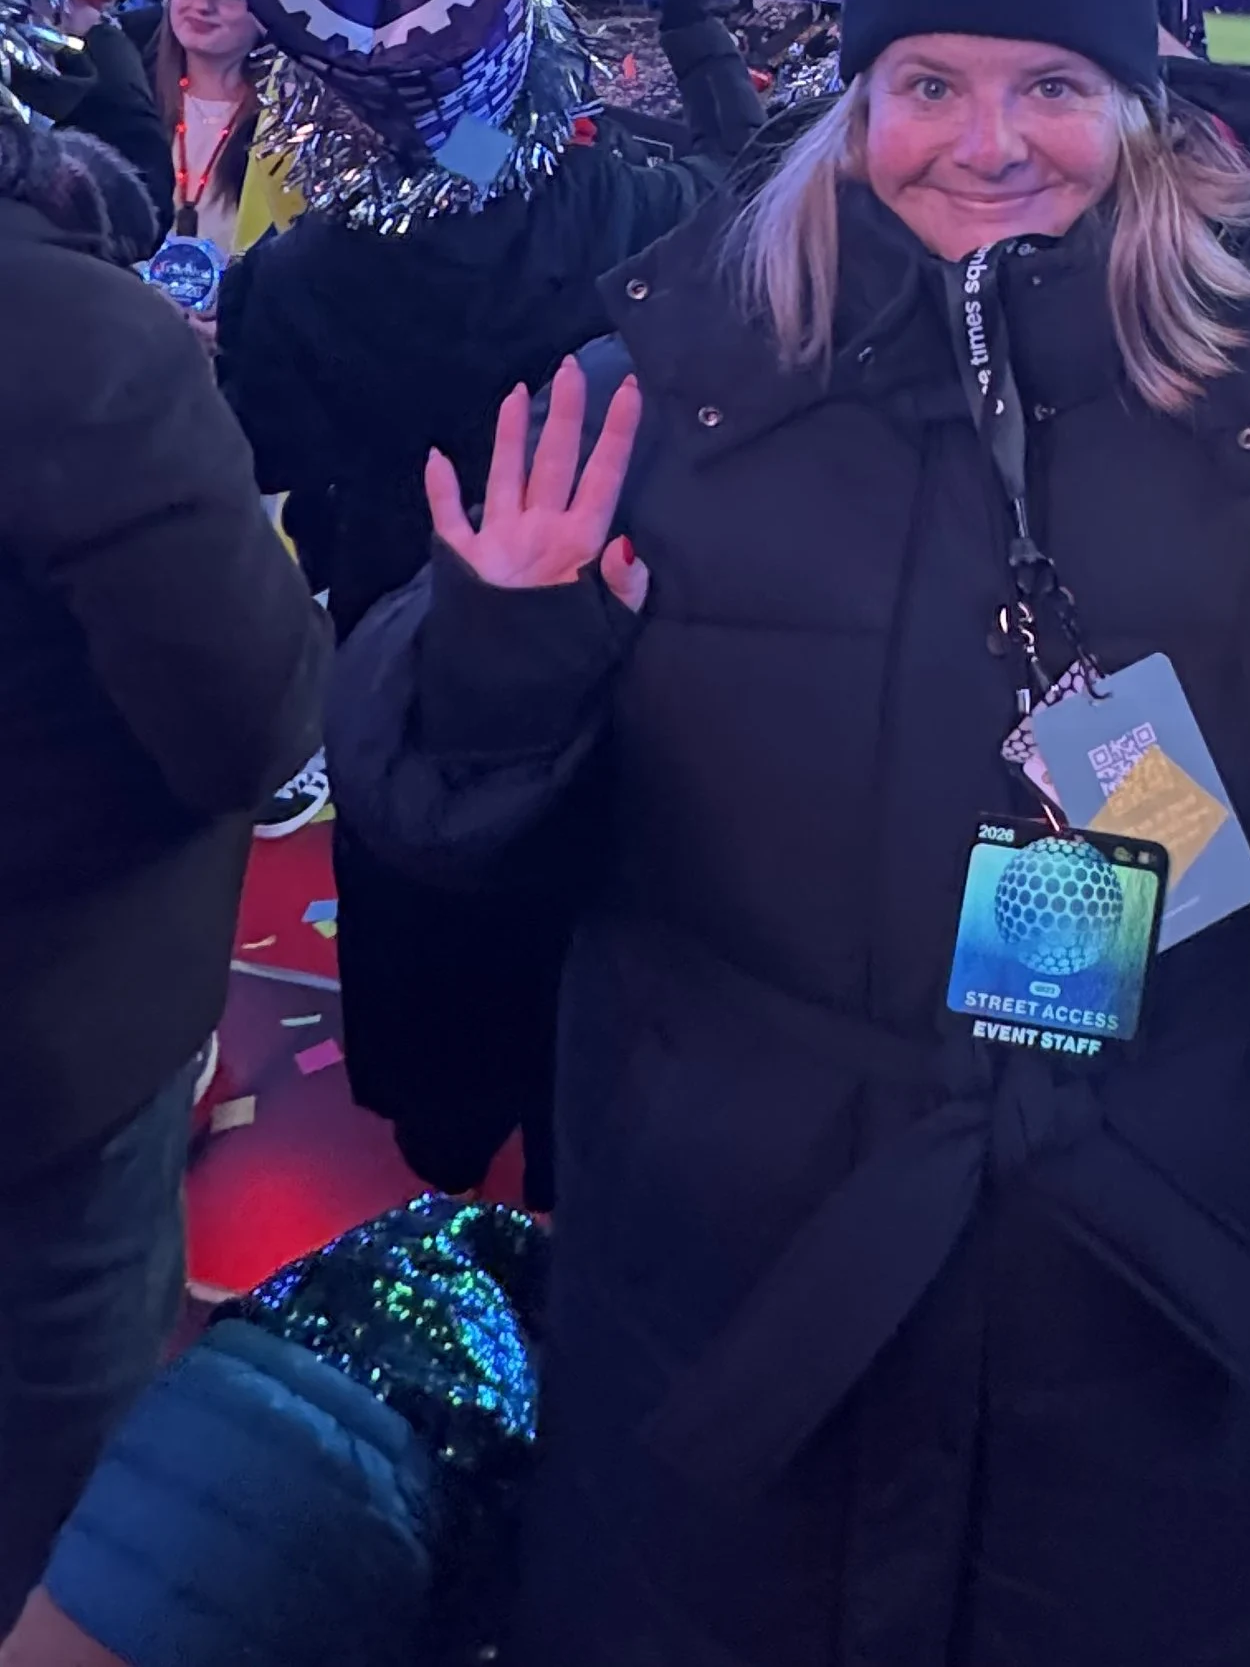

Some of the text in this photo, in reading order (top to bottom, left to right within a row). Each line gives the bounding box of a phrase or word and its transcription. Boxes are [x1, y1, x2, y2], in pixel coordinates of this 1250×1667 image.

[964, 300, 989, 367] times
[978, 824, 1016, 843] 2026
[964, 990, 1040, 1017] STREET
[1041, 1003, 1120, 1030] ACCESS
[972, 1020, 1103, 1057] EVENT STAFF
